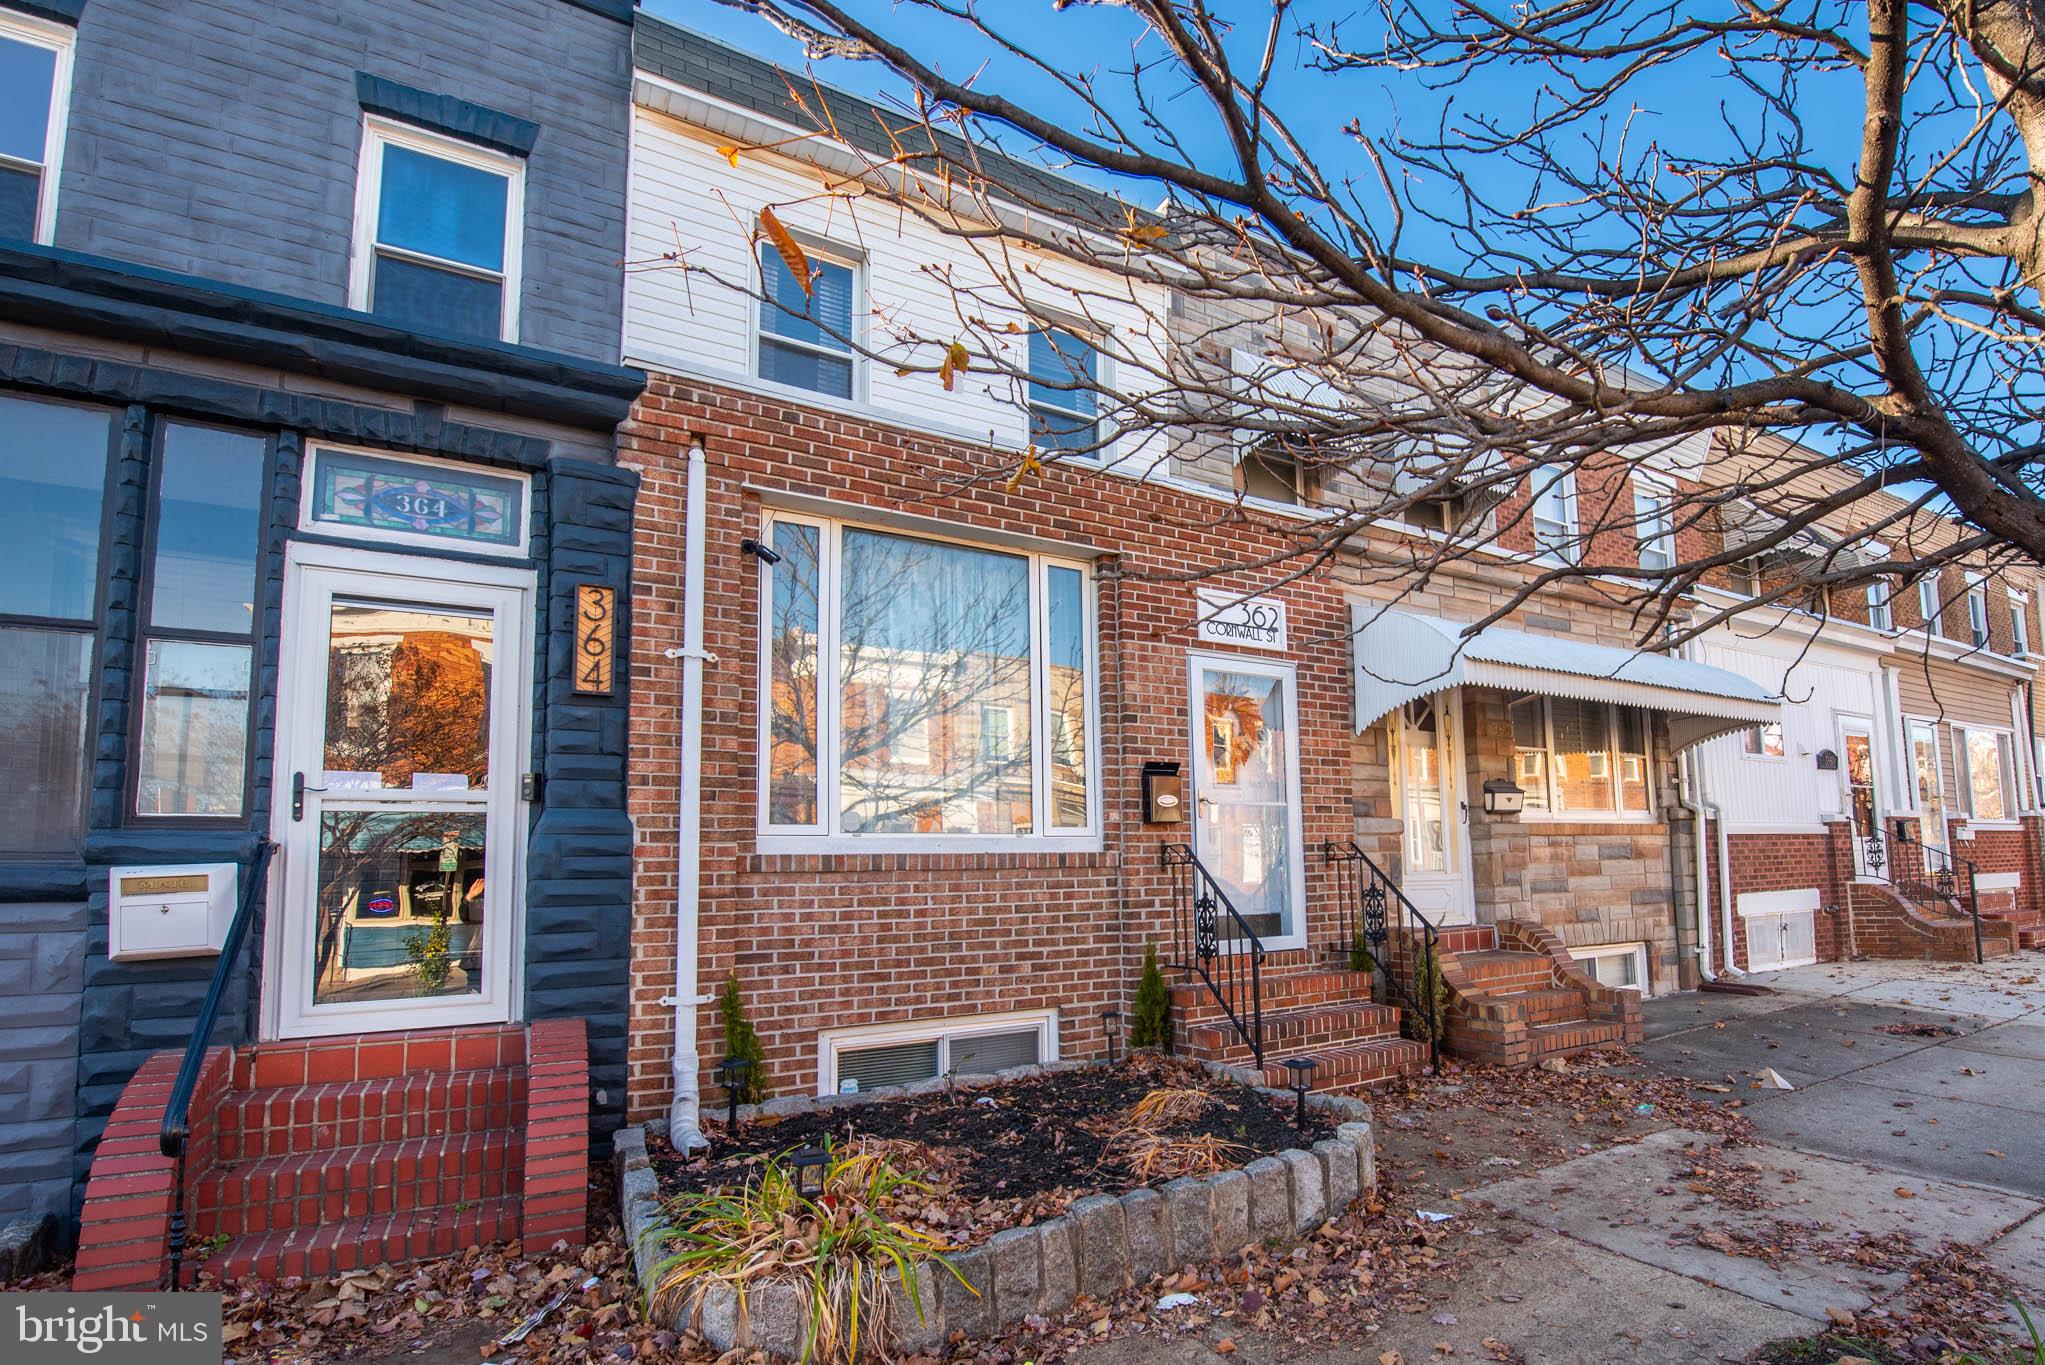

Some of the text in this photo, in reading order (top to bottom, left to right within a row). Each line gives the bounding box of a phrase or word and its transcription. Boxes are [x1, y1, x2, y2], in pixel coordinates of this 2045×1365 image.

[396, 495, 446, 518] 364
[1241, 603, 1278, 629] 362
[583, 588, 606, 691] 364
[1206, 621, 1277, 644] CORNWALL ST
